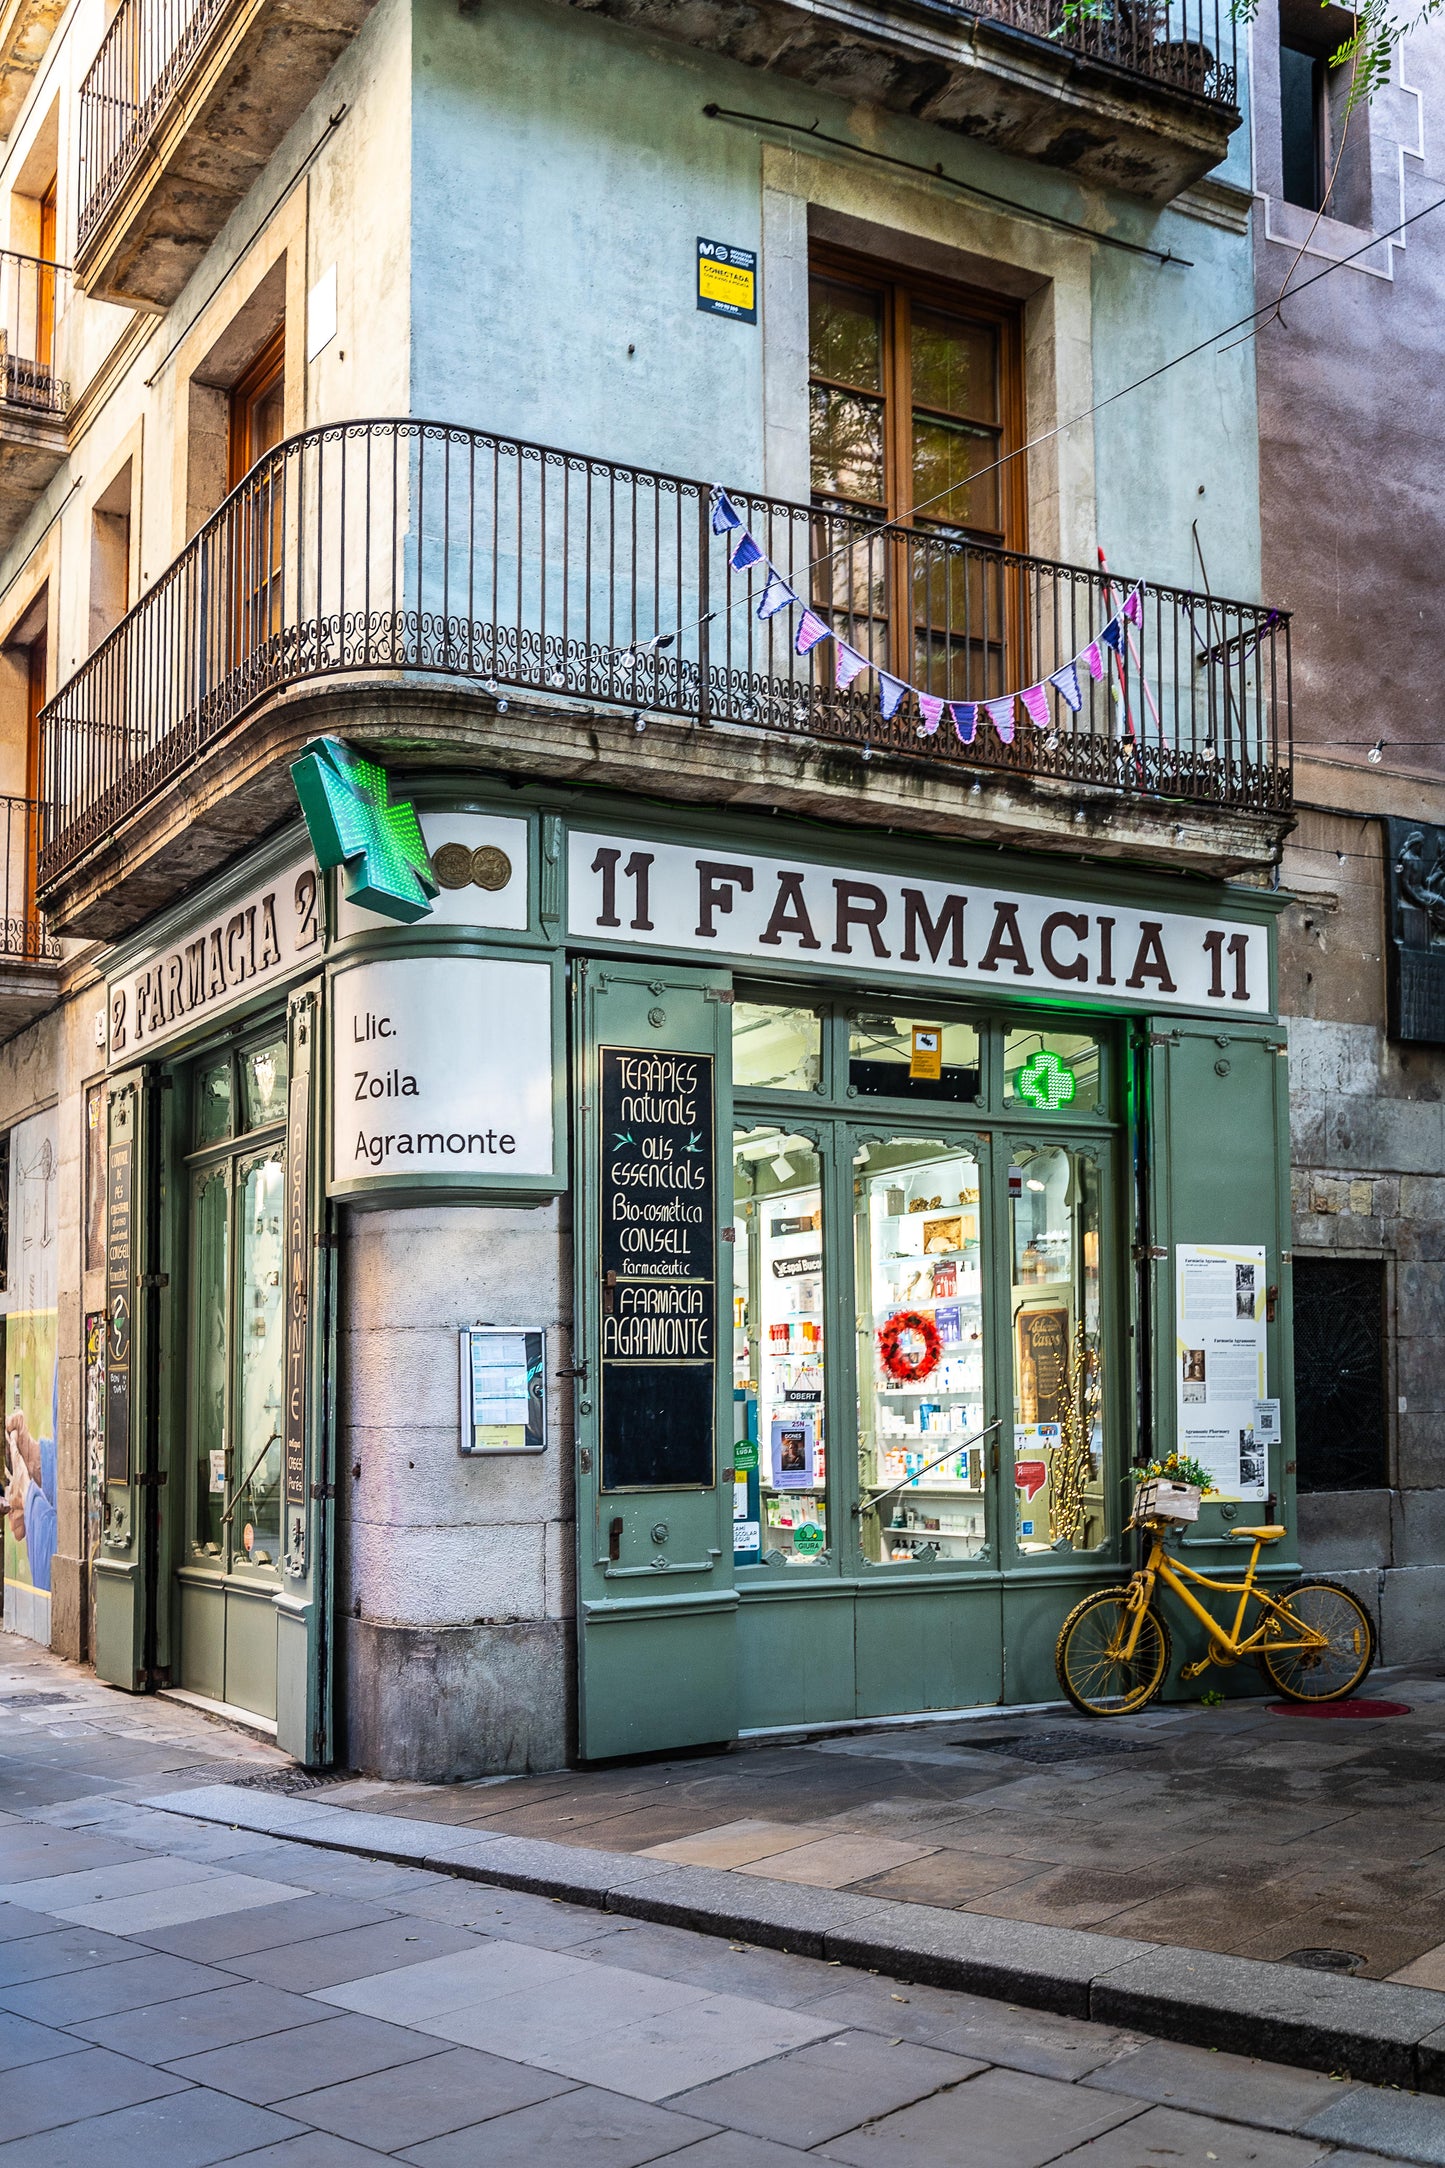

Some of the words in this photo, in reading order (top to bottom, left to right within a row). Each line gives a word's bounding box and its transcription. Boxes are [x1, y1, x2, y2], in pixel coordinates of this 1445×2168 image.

[590, 847, 655, 931] 11
[694, 859, 1178, 993] FARMACIA
[1201, 929, 1251, 1001] 11
[111, 988, 127, 1052] 2
[134, 892, 281, 1040] FARMACIA
[294, 869, 319, 952] 2
[353, 1012, 397, 1043] Llic.
[354, 1068, 420, 1101] Zoila
[621, 1091, 696, 1126] naturals
[354, 1128, 516, 1166] Agramonte
[612, 1192, 702, 1223] Bio-cosmètica
[619, 1227, 691, 1254] CONSELL
[291, 1121, 302, 1421] AGRAMONTE
[622, 1258, 691, 1276] farmacèutic
[619, 1285, 703, 1314] FARMÀCIA
[603, 1316, 709, 1355] AGRAMONTE
[790, 1392, 816, 1400] OBERT
